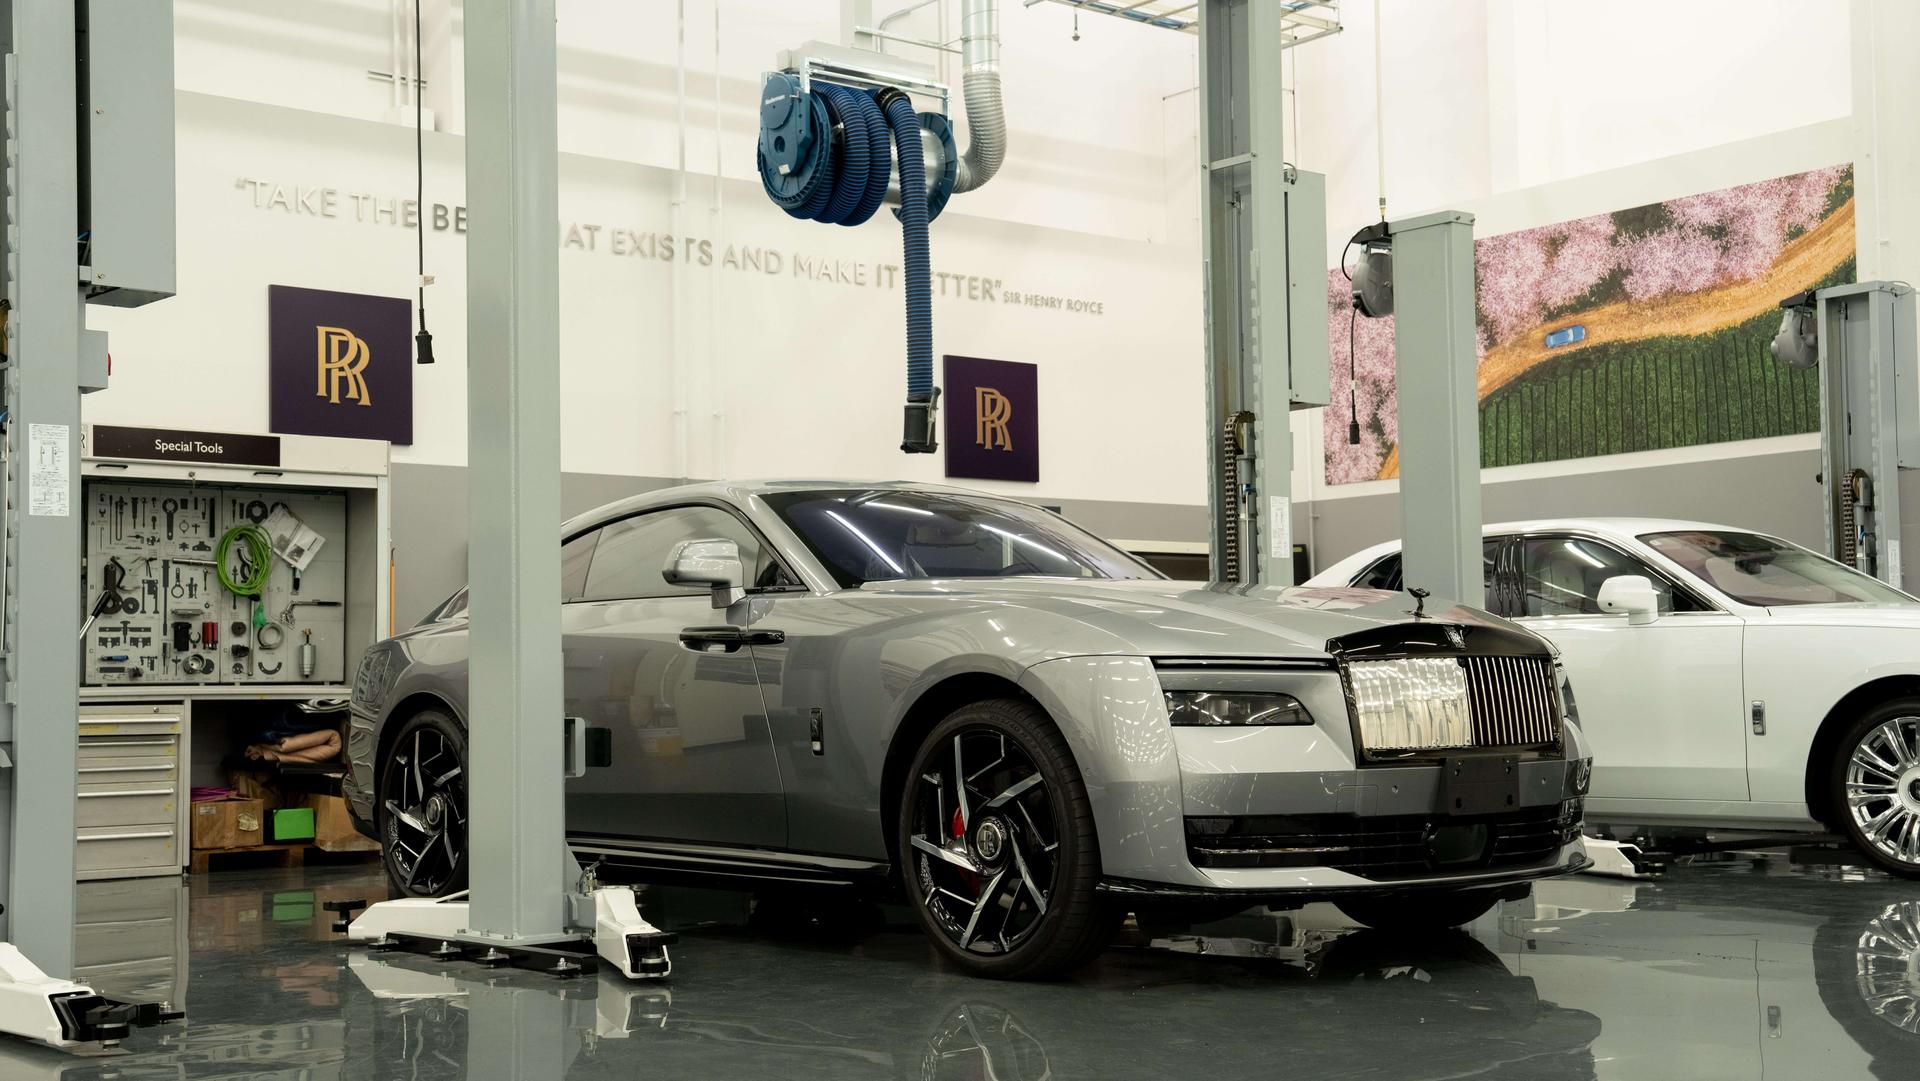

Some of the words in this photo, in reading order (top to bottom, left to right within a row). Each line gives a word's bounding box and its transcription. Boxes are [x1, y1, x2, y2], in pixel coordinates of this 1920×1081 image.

[349, 192, 418, 228] THE
[432, 203, 467, 234] BE
[564, 222, 602, 250] AT
[611, 229, 713, 267] EXISTS
[722, 243, 783, 275] AND
[792, 252, 866, 287] MAKE
[875, 263, 899, 290] IT
[933, 270, 1002, 302] TTER”
[1003, 290, 1022, 305] SIR
[1024, 293, 1063, 309] HENRY
[1066, 298, 1104, 315] ROYCE
[155, 439, 193, 454] Special
[194, 441, 223, 454] Tools
